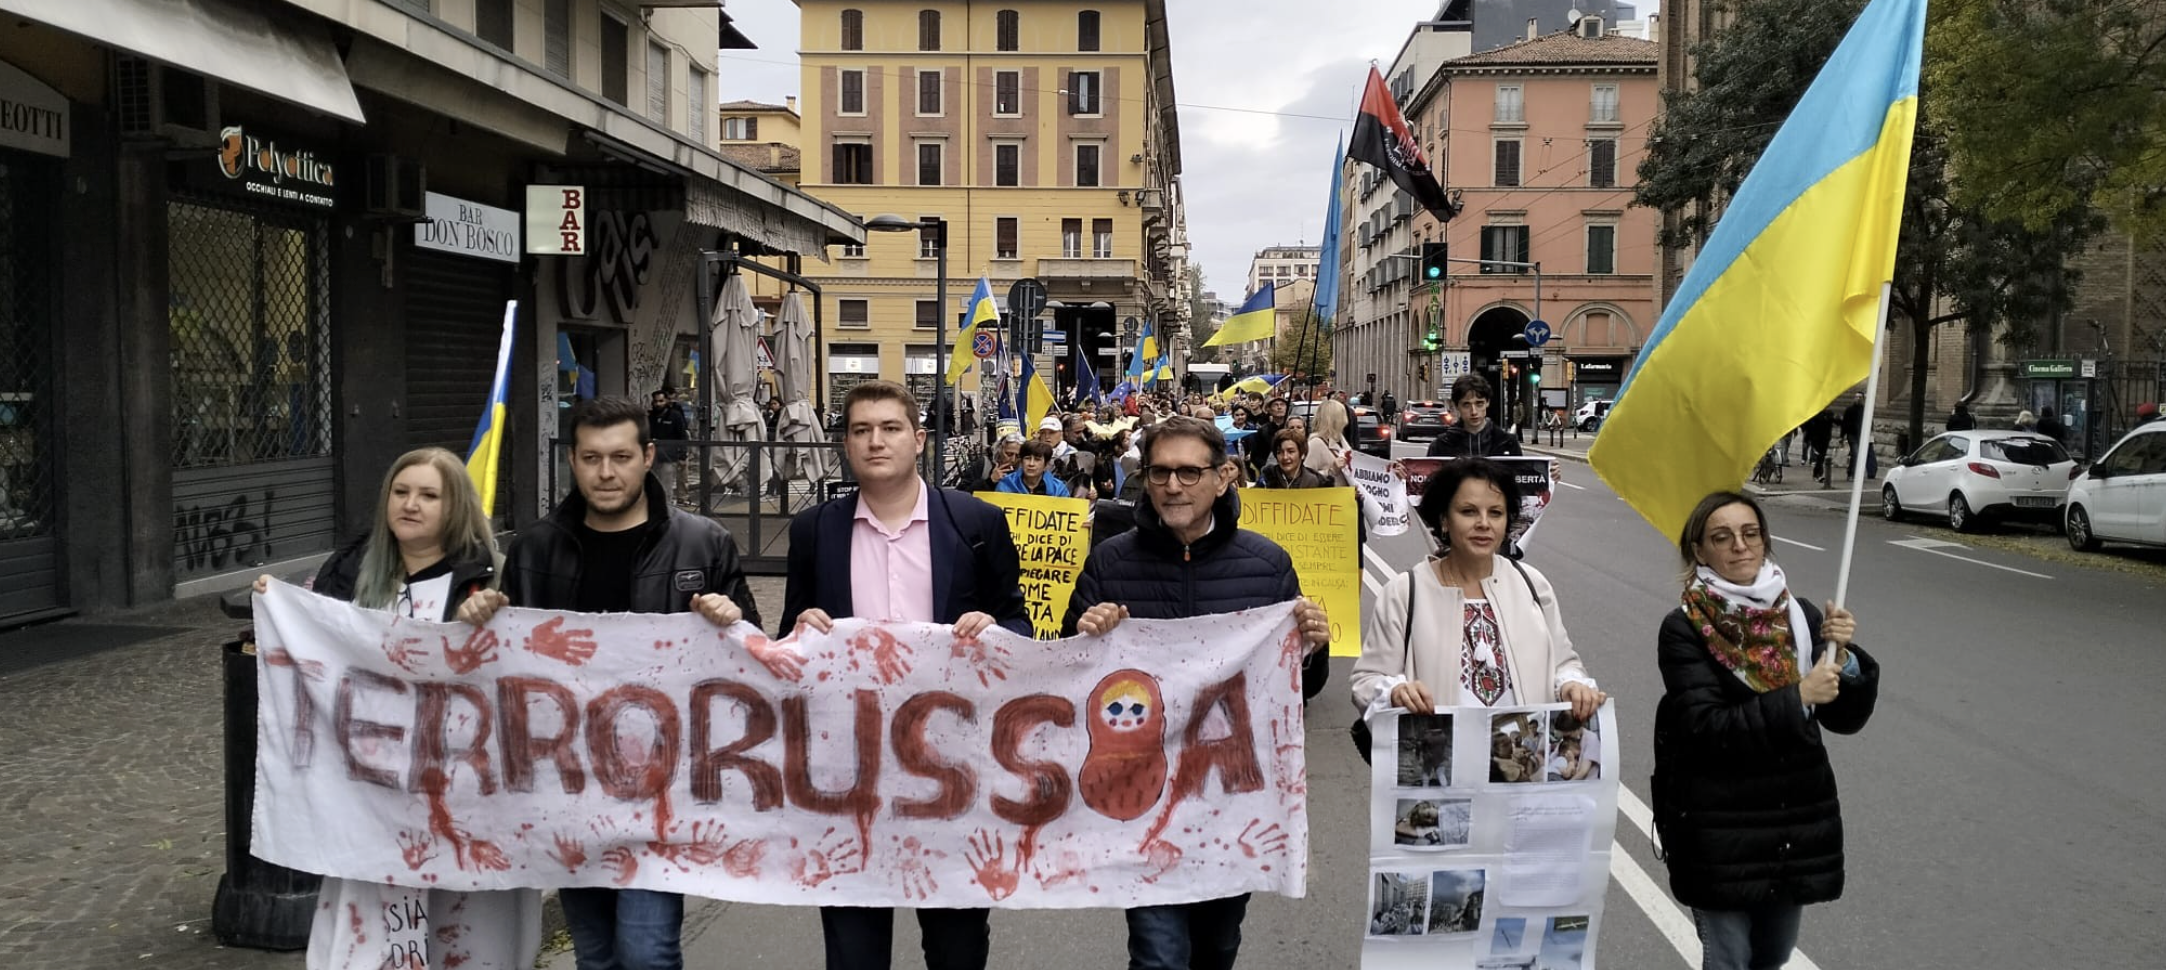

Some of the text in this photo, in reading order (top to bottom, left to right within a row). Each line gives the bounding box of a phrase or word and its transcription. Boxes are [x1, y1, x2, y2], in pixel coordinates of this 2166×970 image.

[246, 135, 333, 187] Polyottica
[246, 181, 276, 195] OCCHIALI
[277, 187, 282, 197] E
[300, 192, 304, 201] A
[458, 204, 483, 226] BAR
[559, 189, 581, 252] BAR
[423, 217, 513, 257] DON BOSCO
[1243, 502, 1346, 526] DIFFIDATE
[1028, 534, 1053, 544] DICE
[1059, 535, 1071, 546] DI
[1046, 546, 1078, 566] PACE
